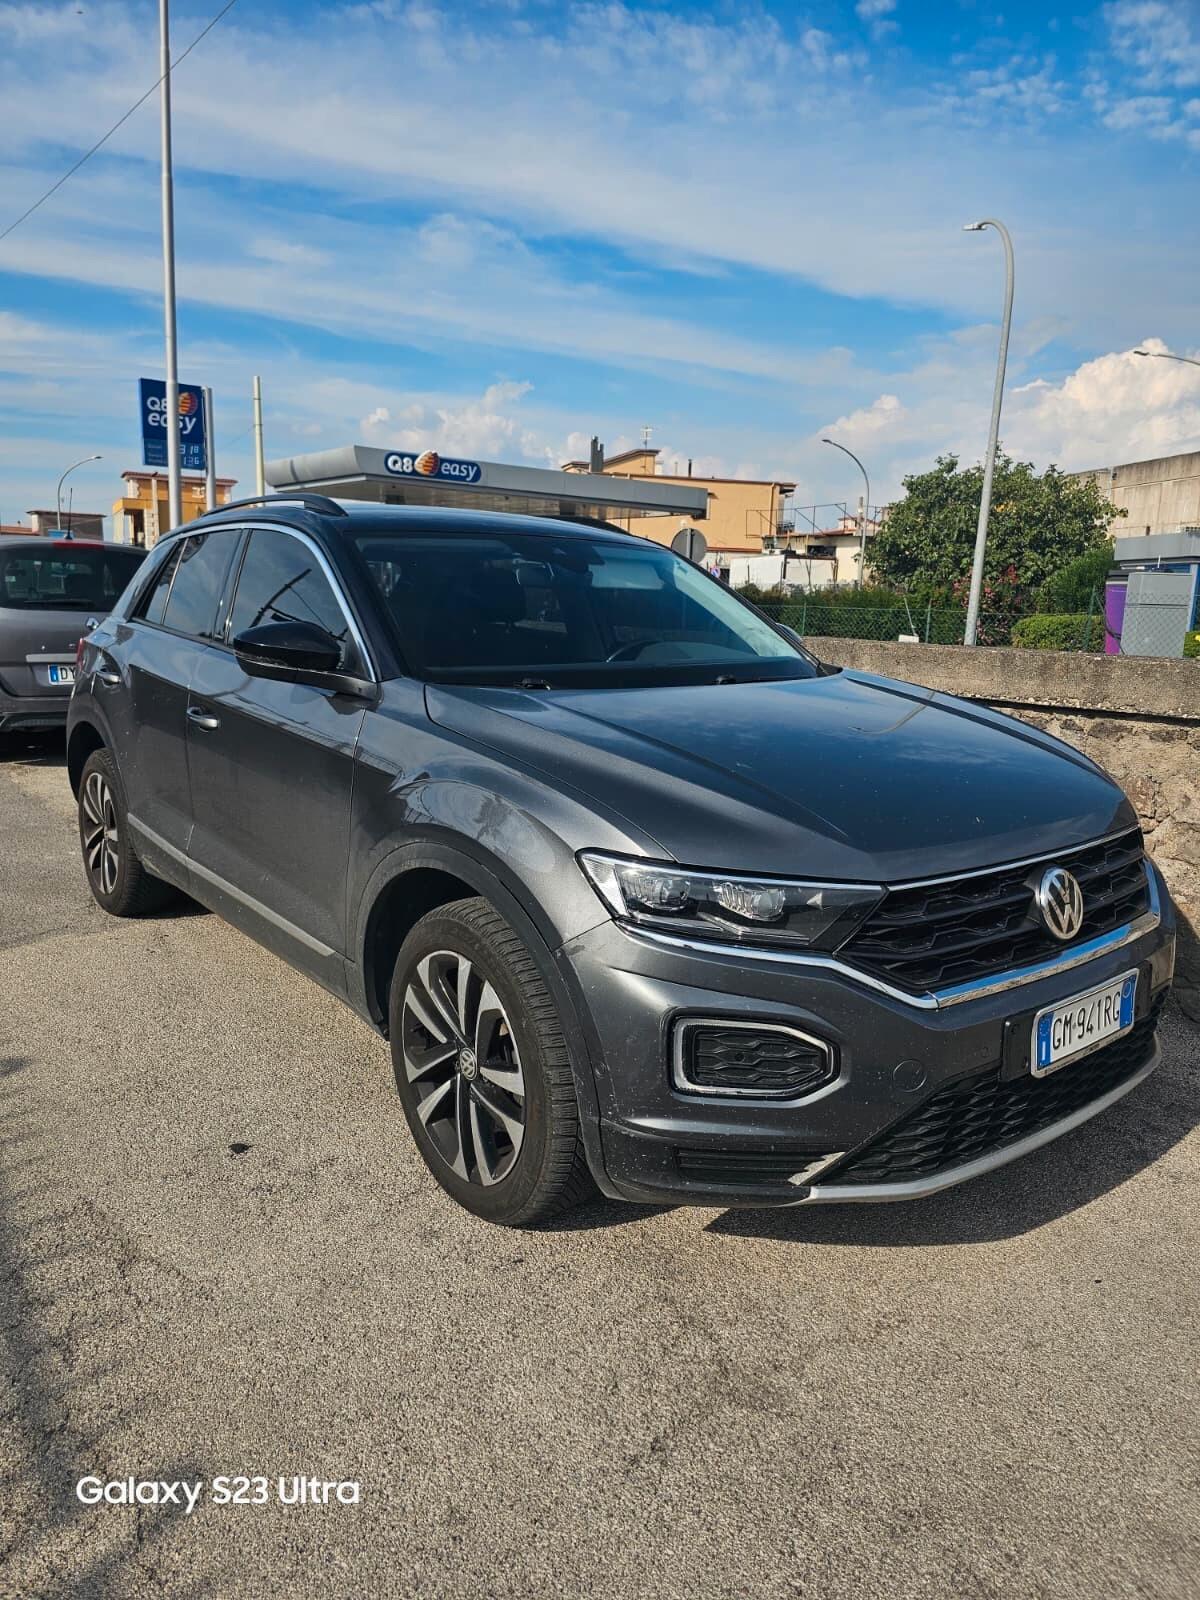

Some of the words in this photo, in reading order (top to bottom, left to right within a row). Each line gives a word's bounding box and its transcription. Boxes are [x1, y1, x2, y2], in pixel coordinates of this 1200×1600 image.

[146, 396, 168, 412] Q8
[387, 455, 413, 473] Q8
[441, 462, 478, 481] easy
